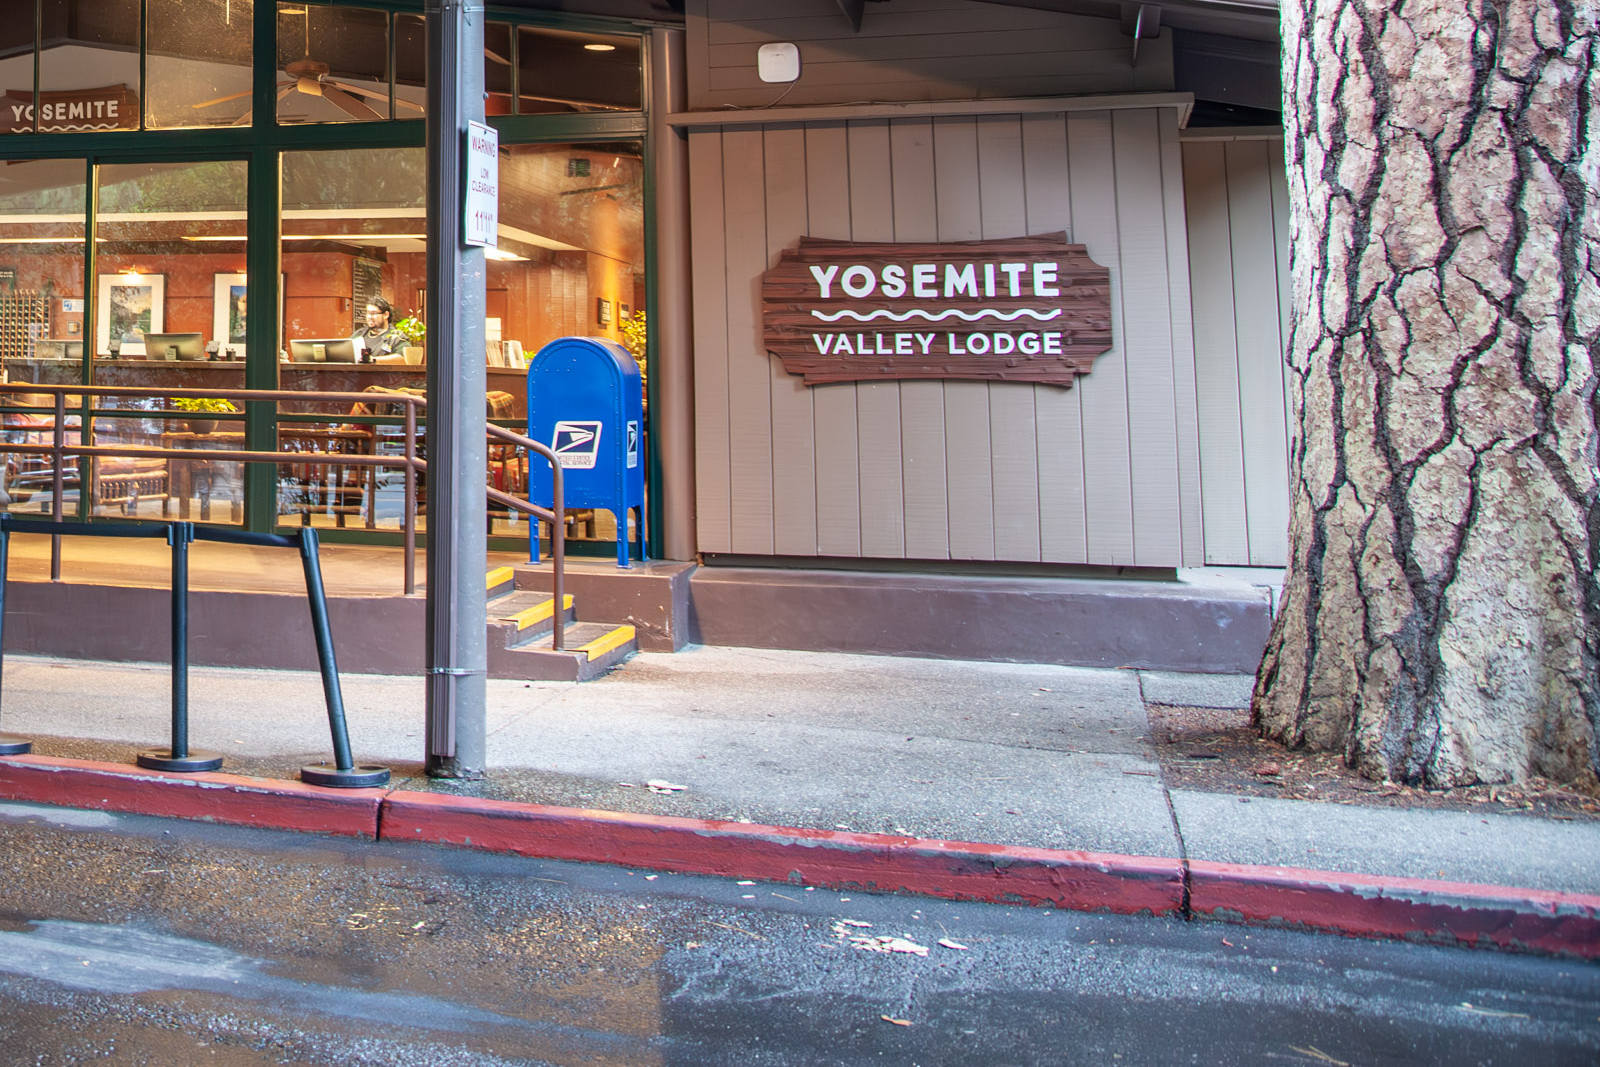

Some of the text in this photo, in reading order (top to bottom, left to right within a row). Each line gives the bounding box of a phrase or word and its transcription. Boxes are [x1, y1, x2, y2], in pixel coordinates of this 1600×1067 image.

[11, 100, 119, 122] YOSEMITE
[472, 135, 495, 158] WARNING
[481, 167, 489, 179] LOW
[472, 180, 495, 197] CLEARANCE
[809, 263, 1061, 298] YOSEMITE
[812, 332, 1063, 355] VALLEY LODGE
